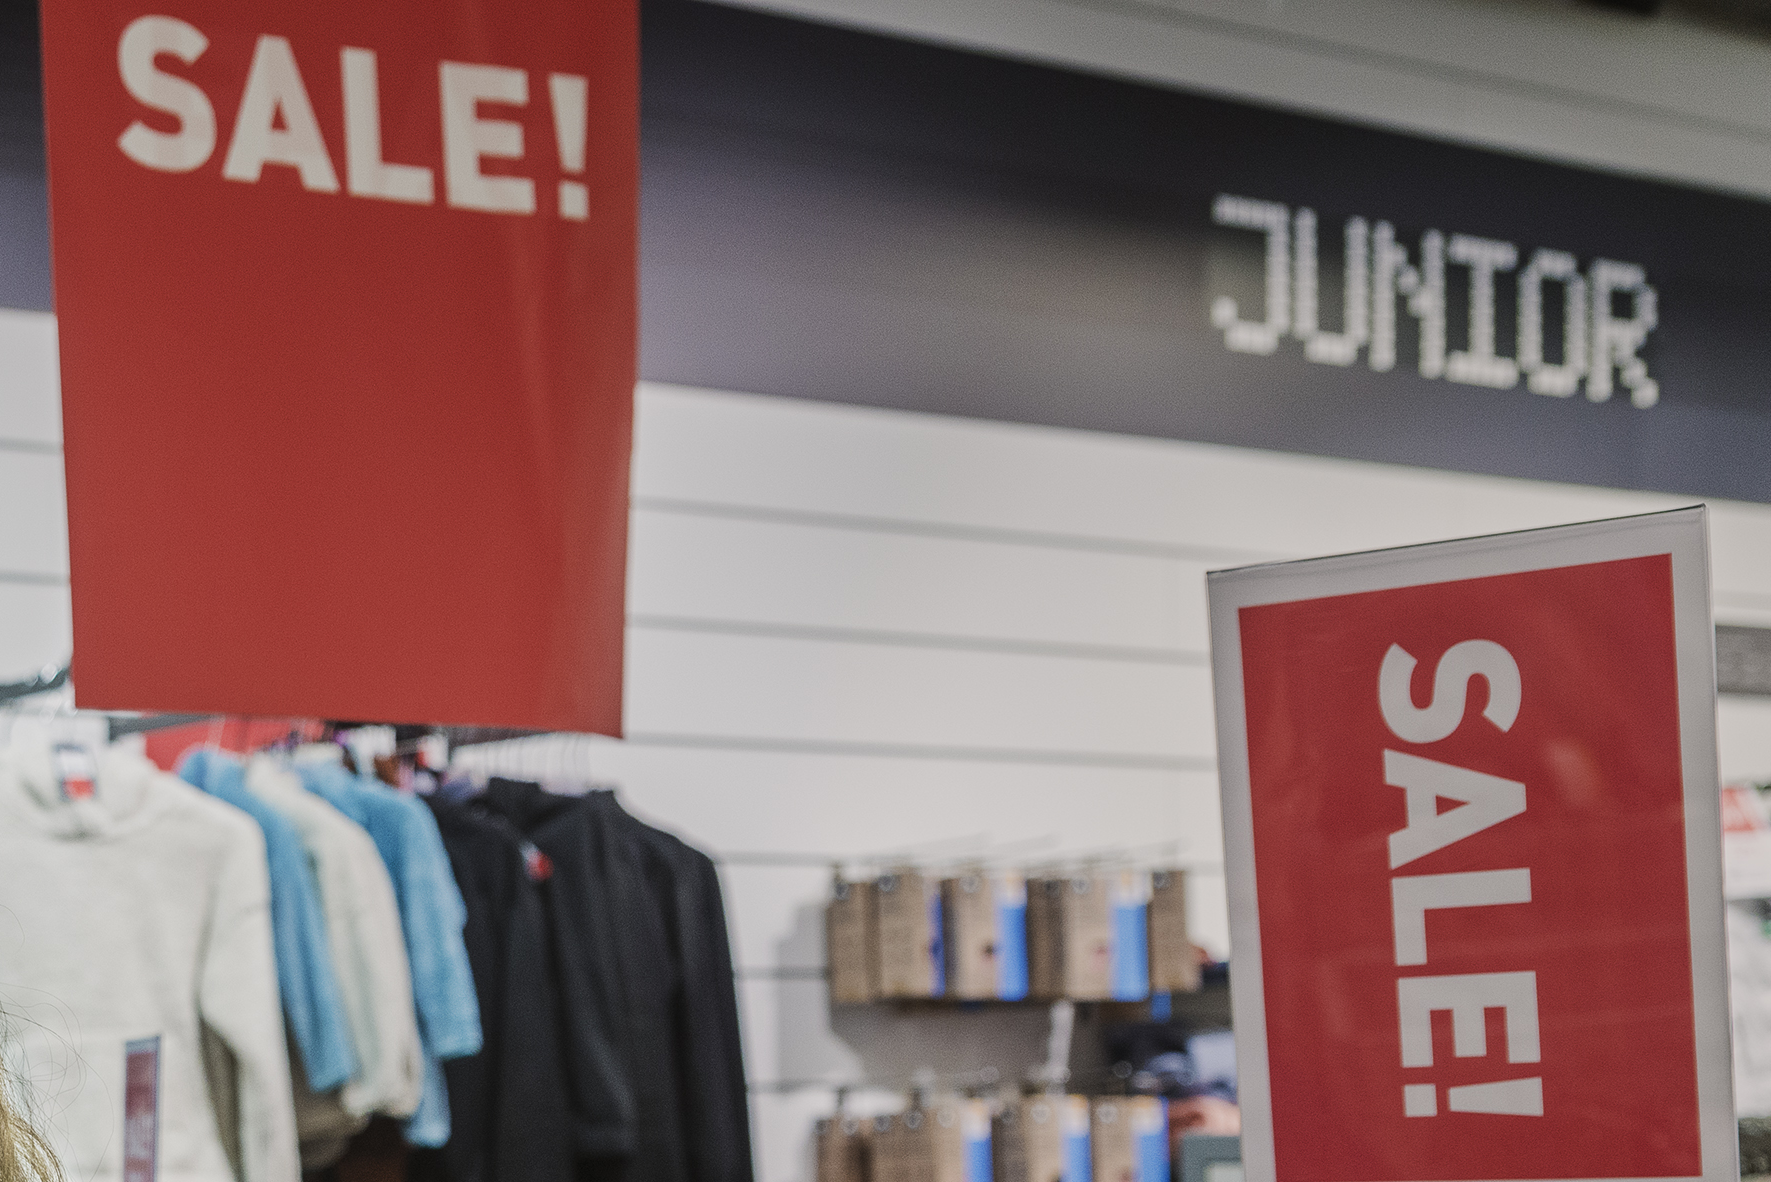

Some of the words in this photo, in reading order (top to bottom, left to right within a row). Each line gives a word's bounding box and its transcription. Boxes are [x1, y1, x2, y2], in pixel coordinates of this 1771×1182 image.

[117, 15, 589, 221] SALE!
[1210, 192, 1659, 408] JUNIOR
[1377, 638, 1545, 1119] SALE!
